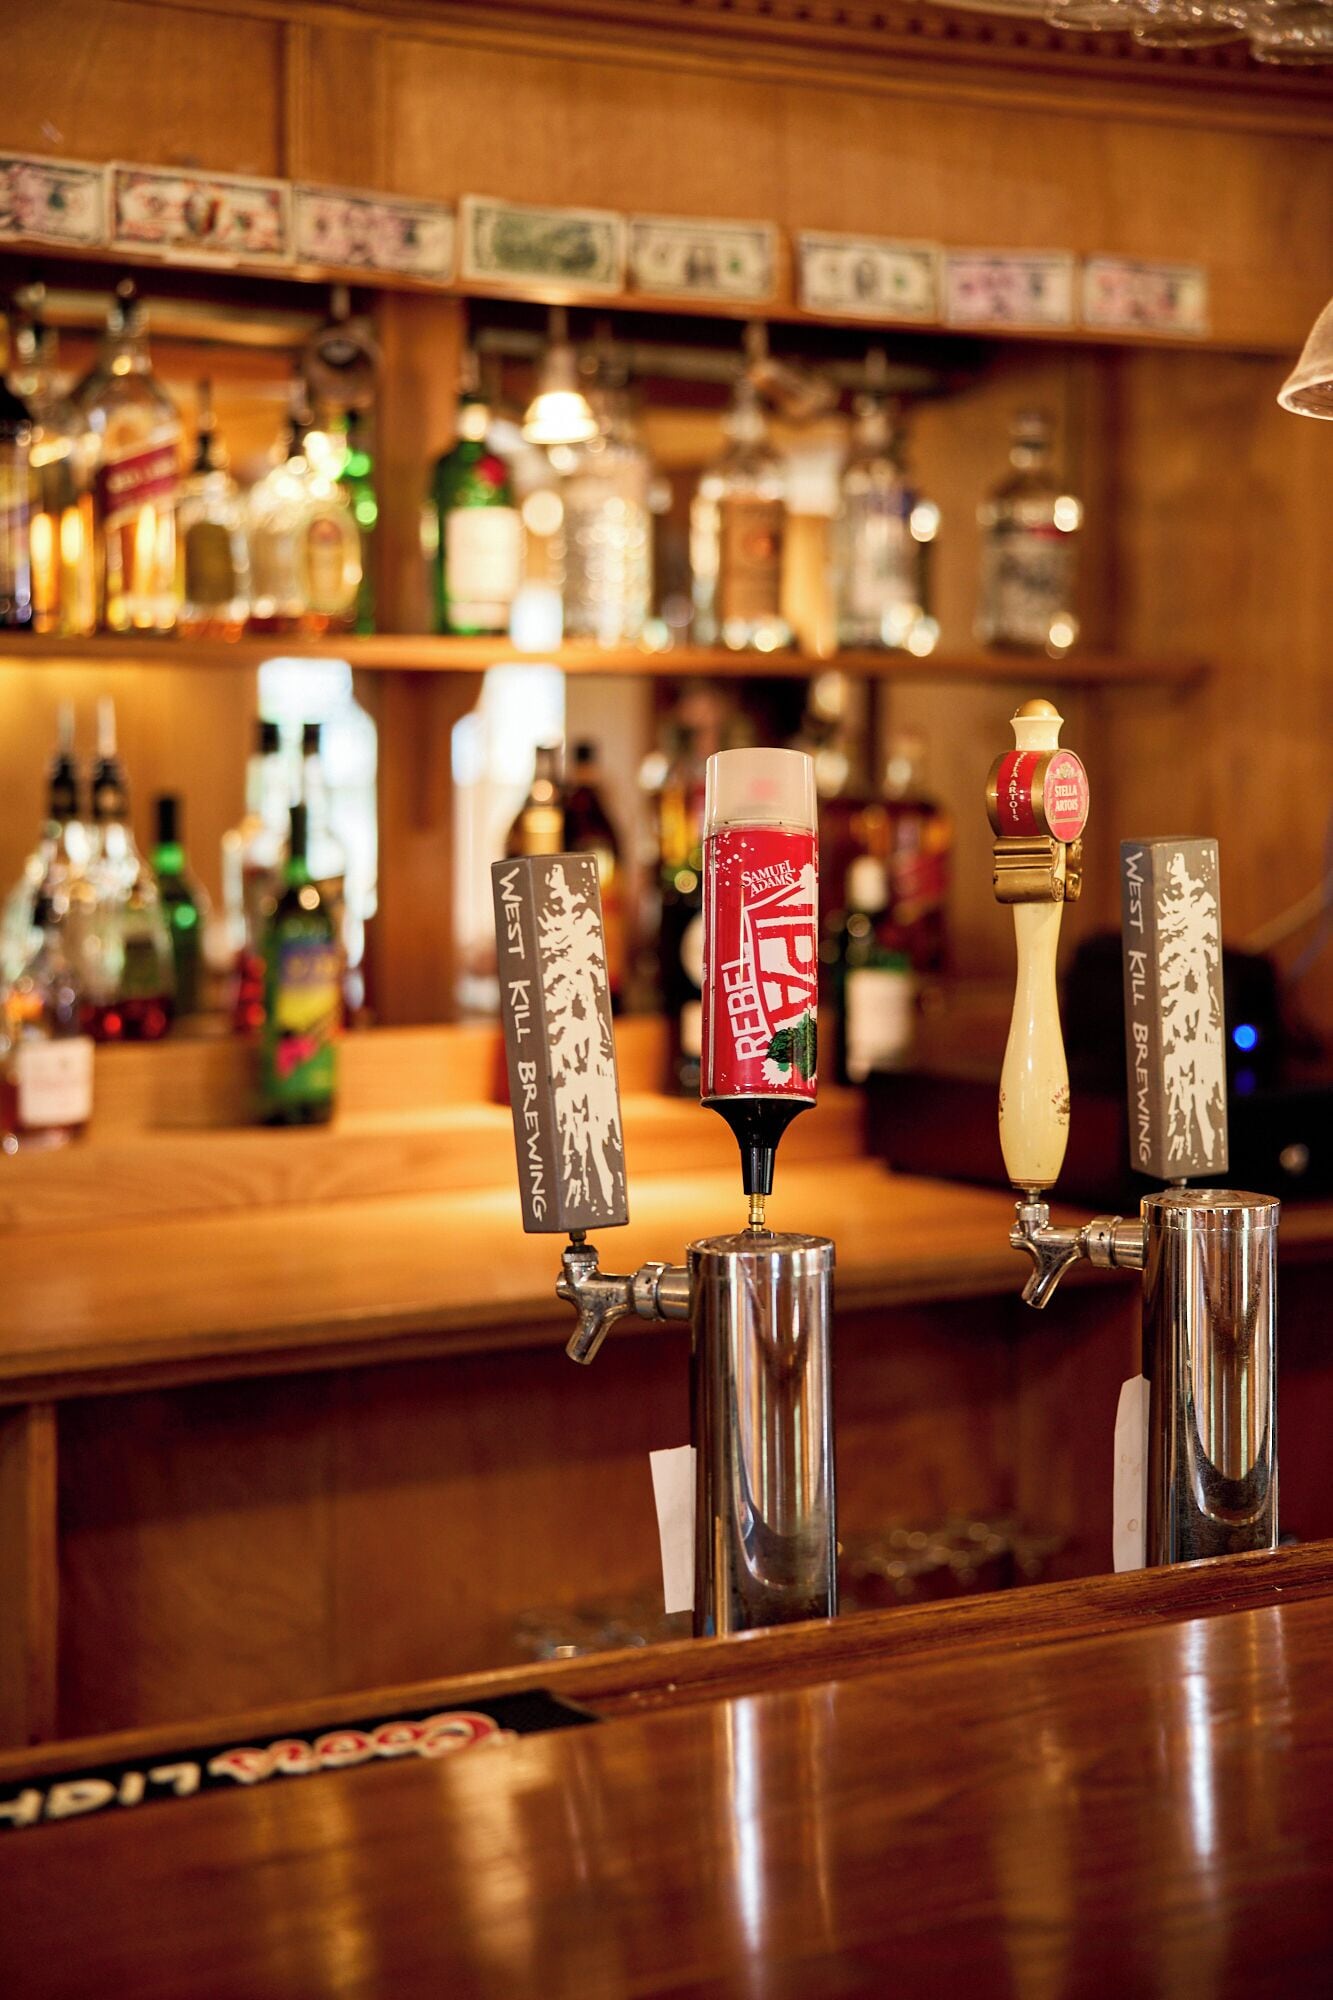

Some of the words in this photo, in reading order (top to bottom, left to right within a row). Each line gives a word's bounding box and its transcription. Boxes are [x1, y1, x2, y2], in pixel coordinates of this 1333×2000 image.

[1008, 780, 1020, 821] ARTOIS
[1055, 785, 1078, 798] STELLA
[1055, 799, 1079, 812] ARTOIS
[740, 859, 796, 887] SAMUEL
[750, 872, 795, 899] ADAMS
[1124, 851, 1145, 933] WEST
[499, 867, 525, 960] WEST
[756, 895, 818, 1034] IPA
[1128, 949, 1147, 1006] KILL
[508, 980, 532, 1043] KILL
[721, 942, 770, 1061] REBEL
[1132, 1024, 1152, 1166] BREWING
[518, 1060, 548, 1222] BREWING
[207, 1710, 500, 1784] Coors
